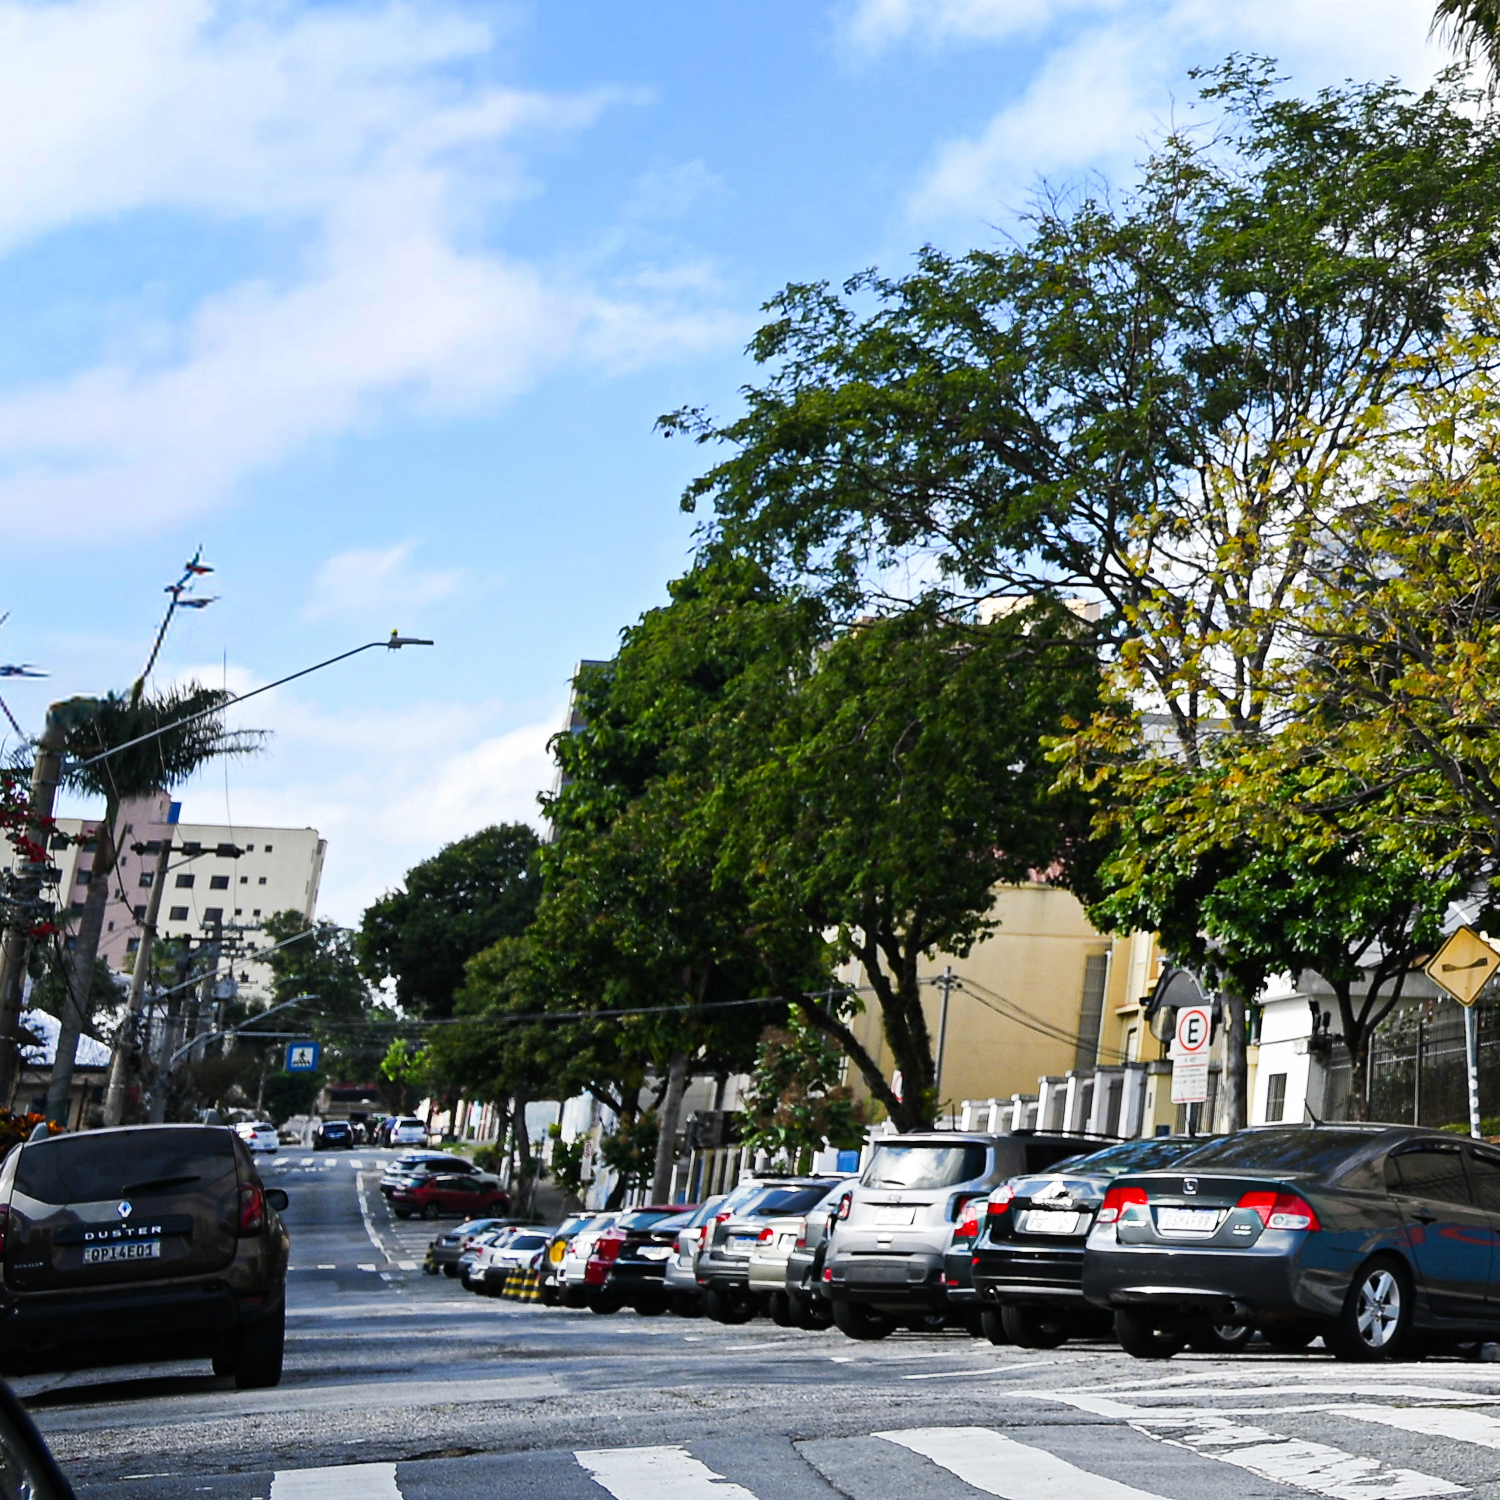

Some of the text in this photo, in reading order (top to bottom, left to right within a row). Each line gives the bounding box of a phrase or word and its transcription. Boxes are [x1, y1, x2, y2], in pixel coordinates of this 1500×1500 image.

[1188, 1018, 1199, 1043] E
[84, 1226, 161, 1240] DUSTER
[91, 1244, 153, 1260] QPI4E01
